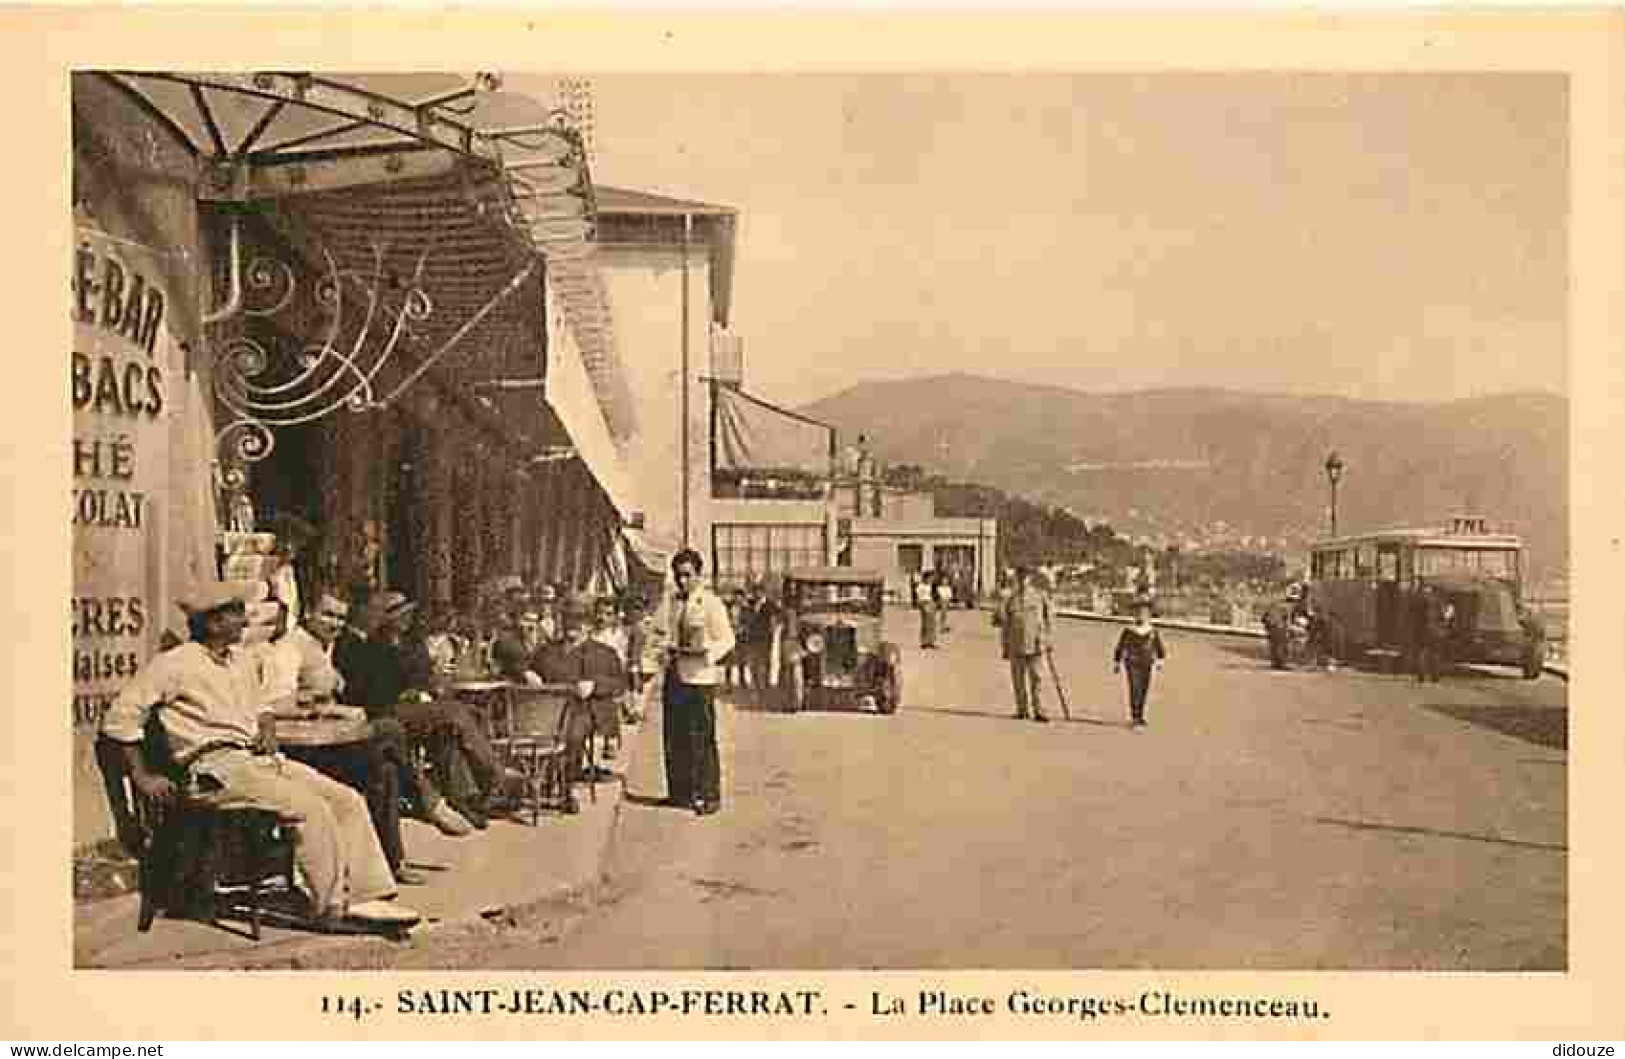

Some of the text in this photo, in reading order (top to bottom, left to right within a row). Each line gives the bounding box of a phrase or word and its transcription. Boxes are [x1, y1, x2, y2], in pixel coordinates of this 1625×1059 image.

[71, 242, 164, 356] É-BAR
[72, 351, 164, 415] BACS
[73, 434, 133, 481] HÉ
[72, 597, 144, 637] RES
